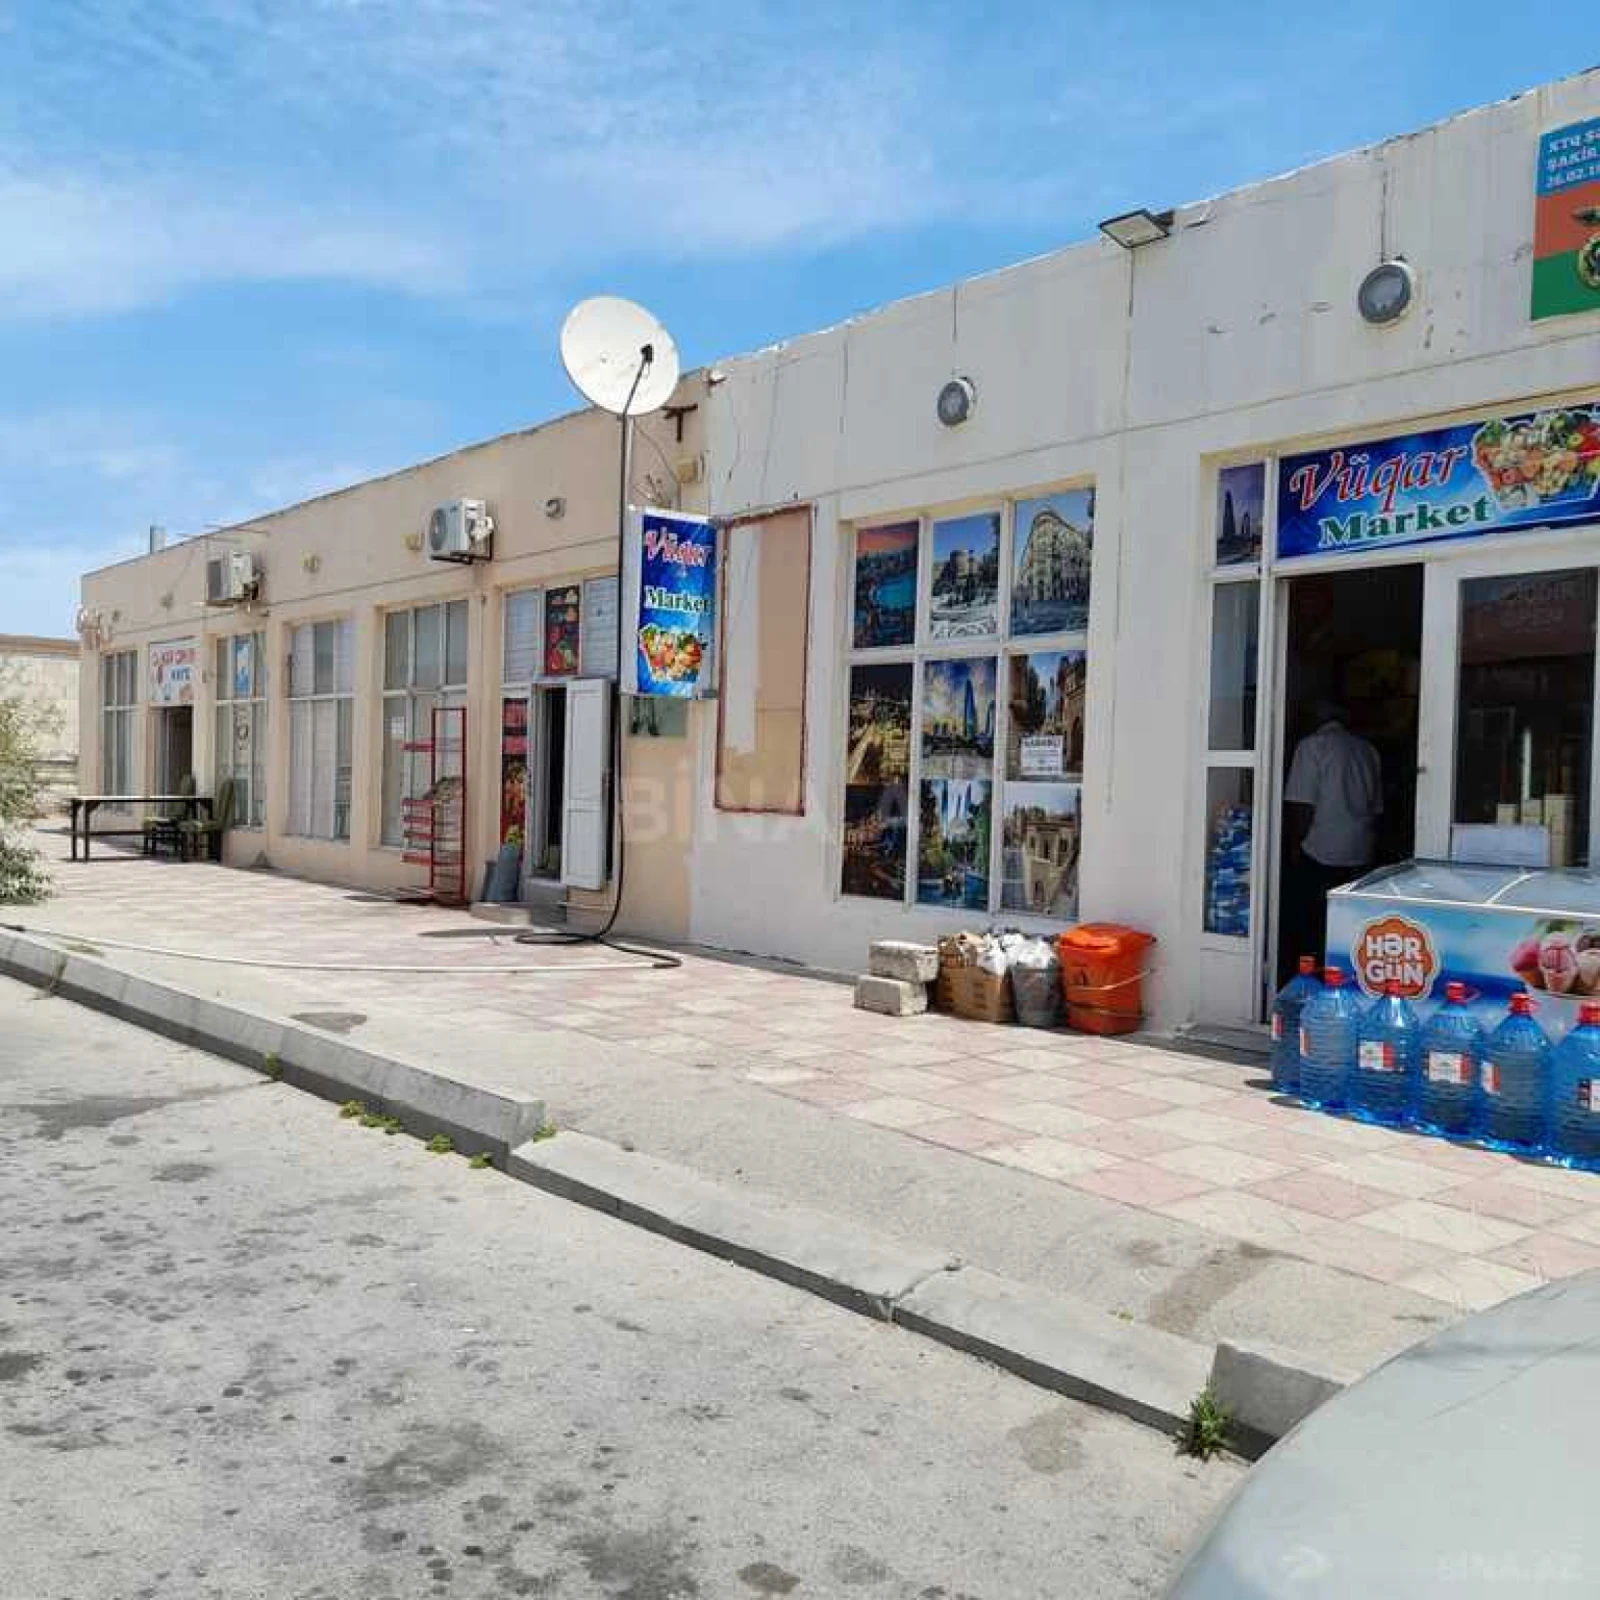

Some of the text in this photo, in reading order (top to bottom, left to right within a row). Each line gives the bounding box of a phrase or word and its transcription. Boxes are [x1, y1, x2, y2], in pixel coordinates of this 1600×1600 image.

[1289, 443, 1468, 513] Vüqar
[1317, 495, 1495, 549] Market
[1366, 956, 1424, 986] GÜN
